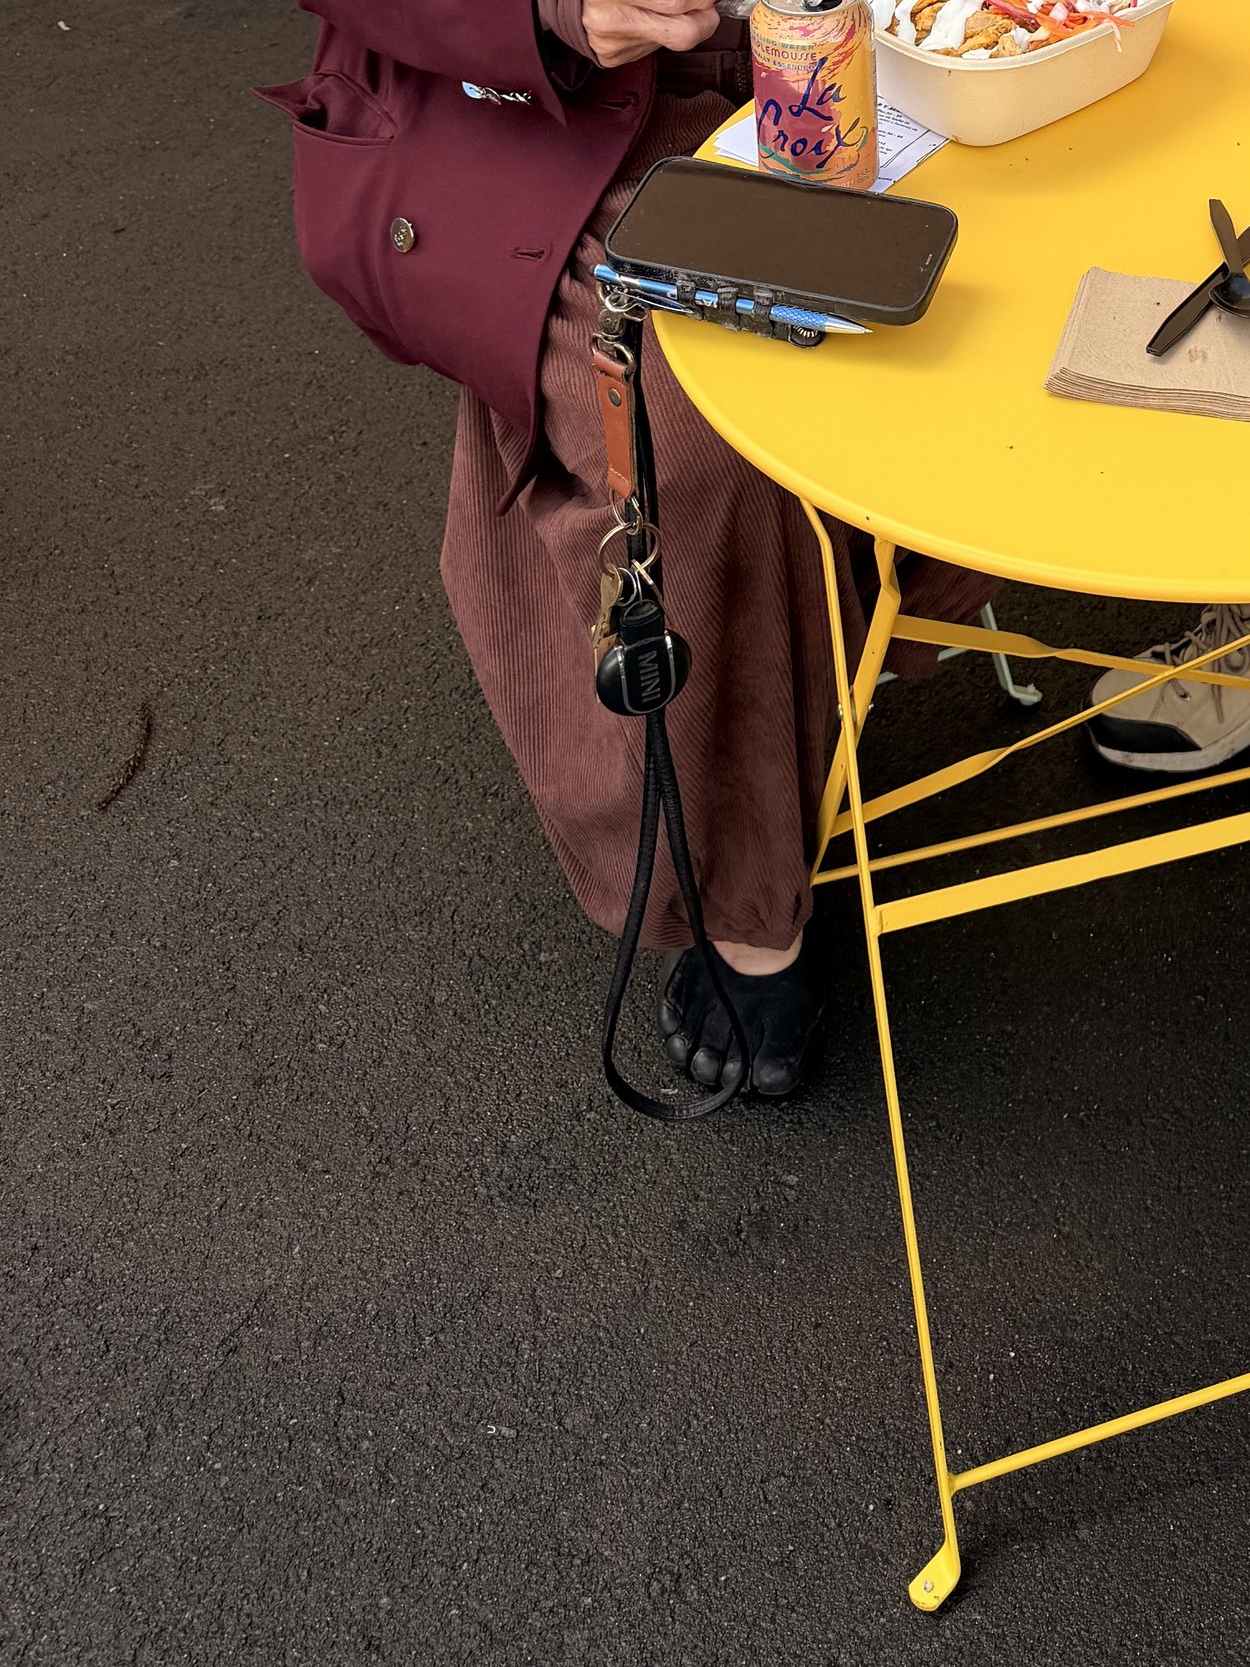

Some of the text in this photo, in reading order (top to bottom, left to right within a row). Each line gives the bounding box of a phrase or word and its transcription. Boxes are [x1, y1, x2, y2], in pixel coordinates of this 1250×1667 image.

[788, 56, 847, 121] La
[758, 99, 868, 168] Croix
[638, 650, 661, 703] MINI
